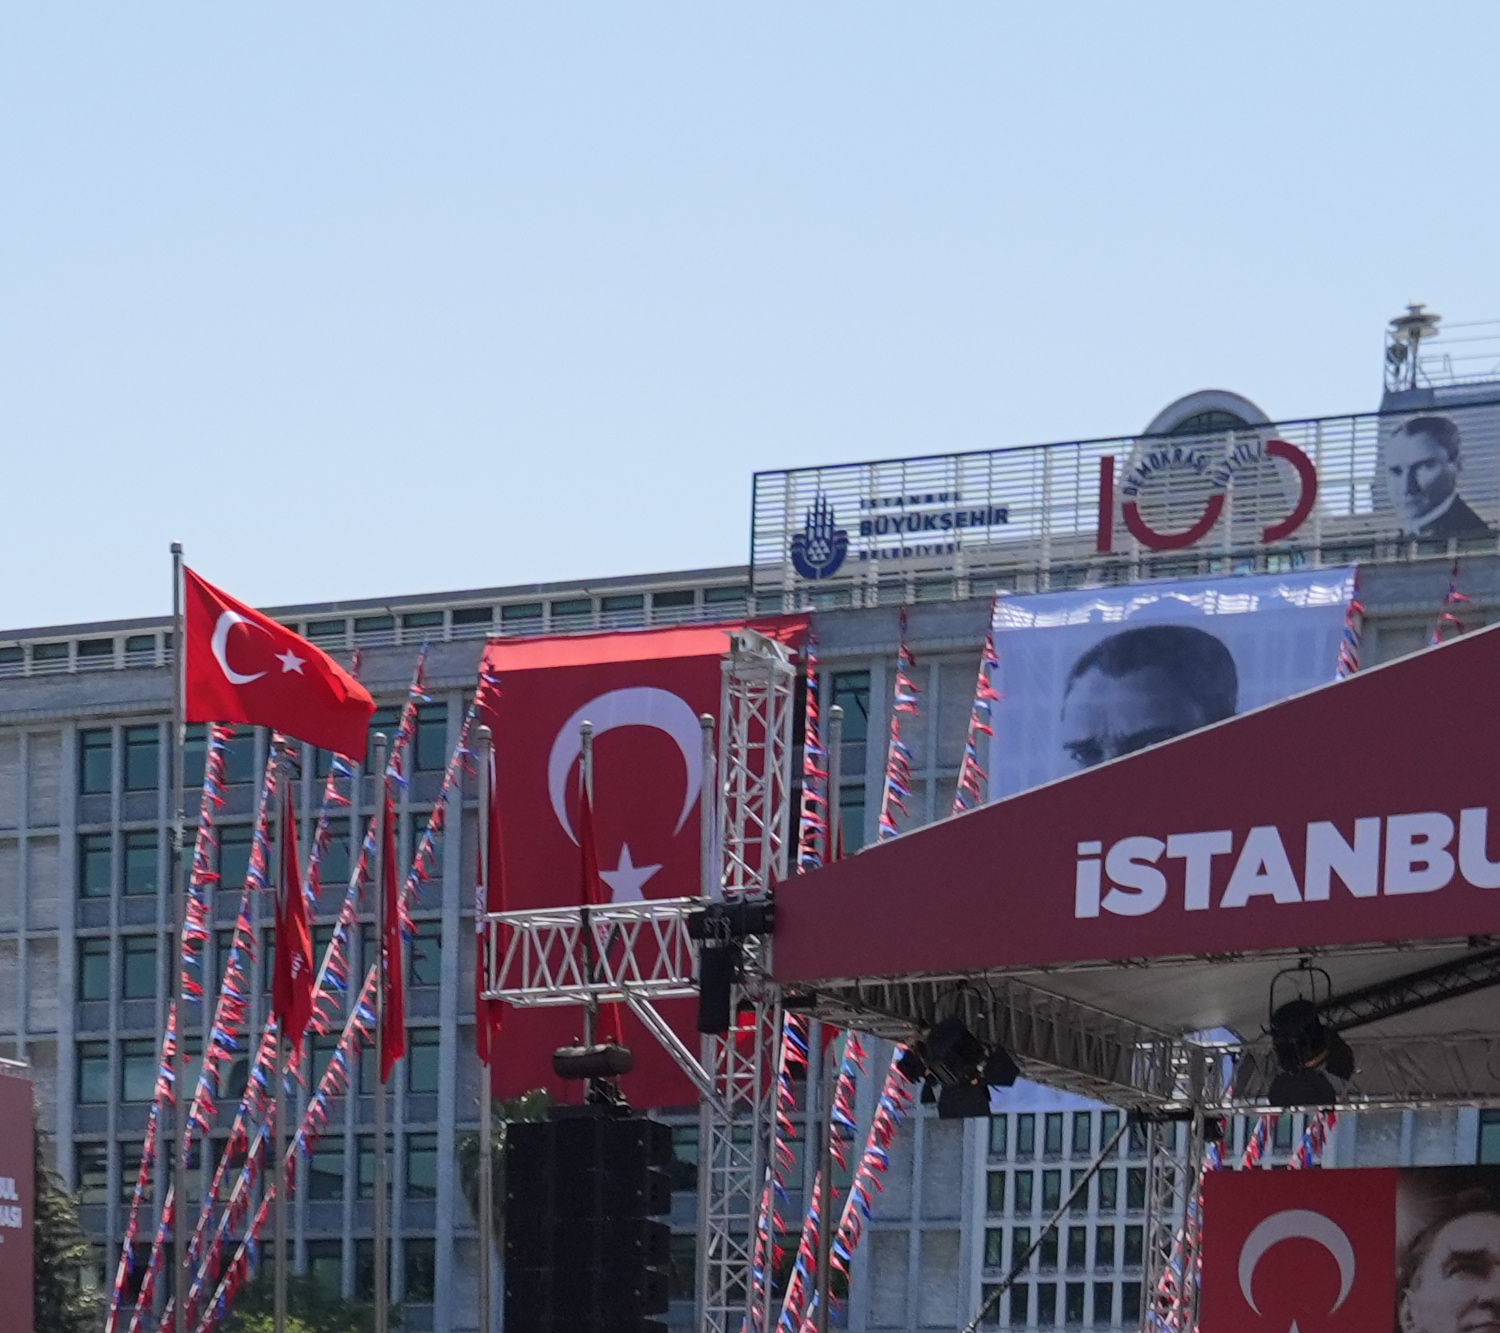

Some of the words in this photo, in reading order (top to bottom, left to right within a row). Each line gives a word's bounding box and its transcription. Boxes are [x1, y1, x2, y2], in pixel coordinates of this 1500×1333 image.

[860, 491, 962, 509] İSTANBUL
[860, 505, 1009, 536] BÜYÜKŞEHİR
[860, 541, 962, 560] BELEDİYESİ
